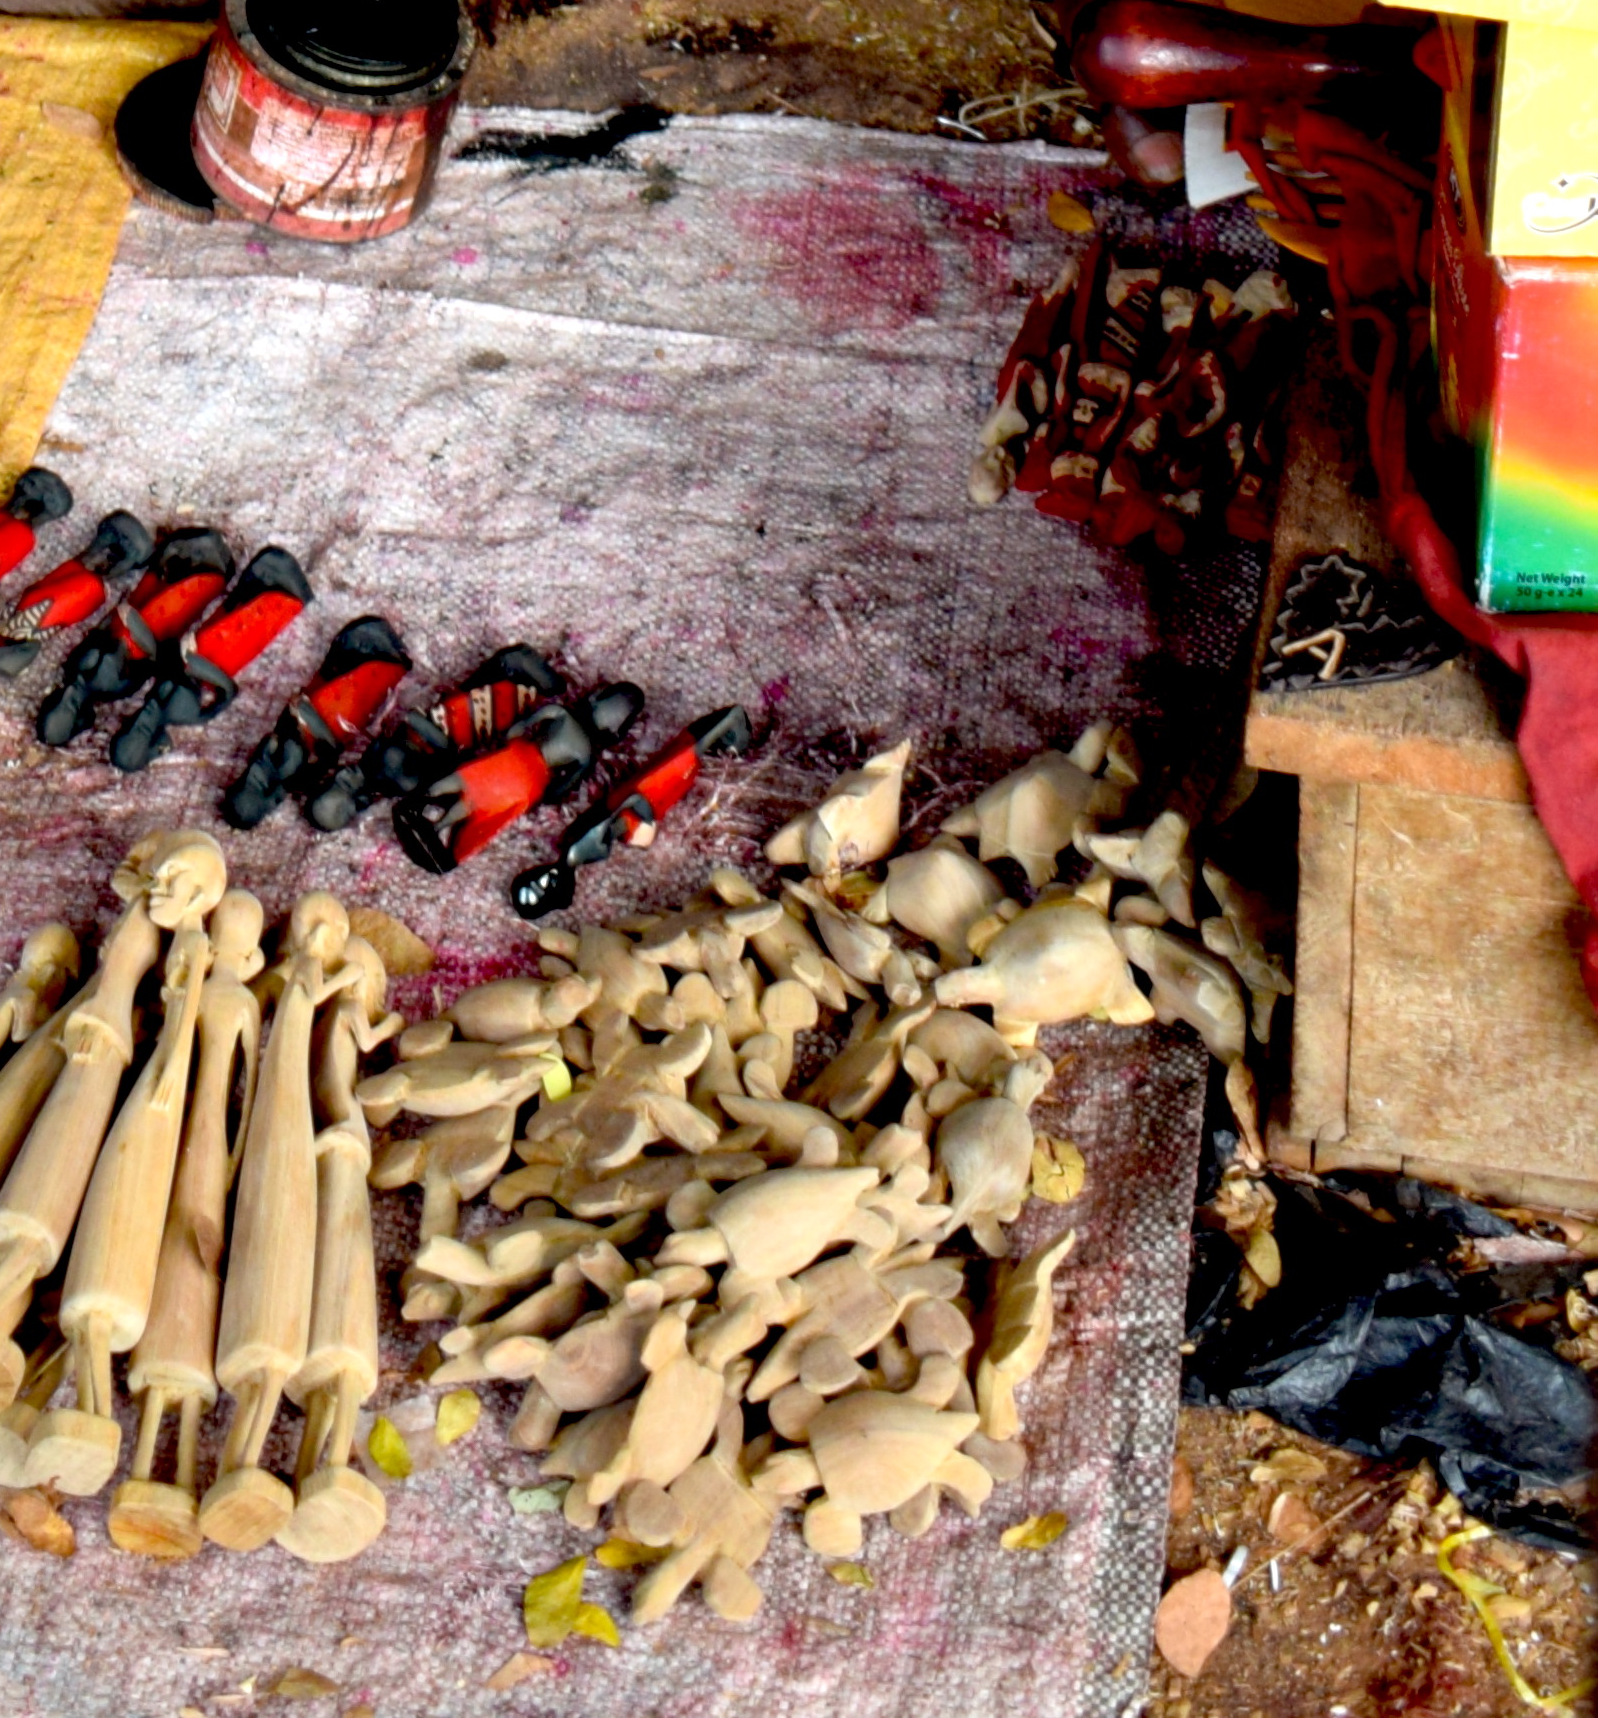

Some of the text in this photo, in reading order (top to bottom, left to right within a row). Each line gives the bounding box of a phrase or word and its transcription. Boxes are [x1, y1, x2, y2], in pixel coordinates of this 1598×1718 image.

[1516, 572, 1586, 587] Net Weight
[1516, 586, 1532, 597] 50
[1568, 587, 1583, 598] 24
